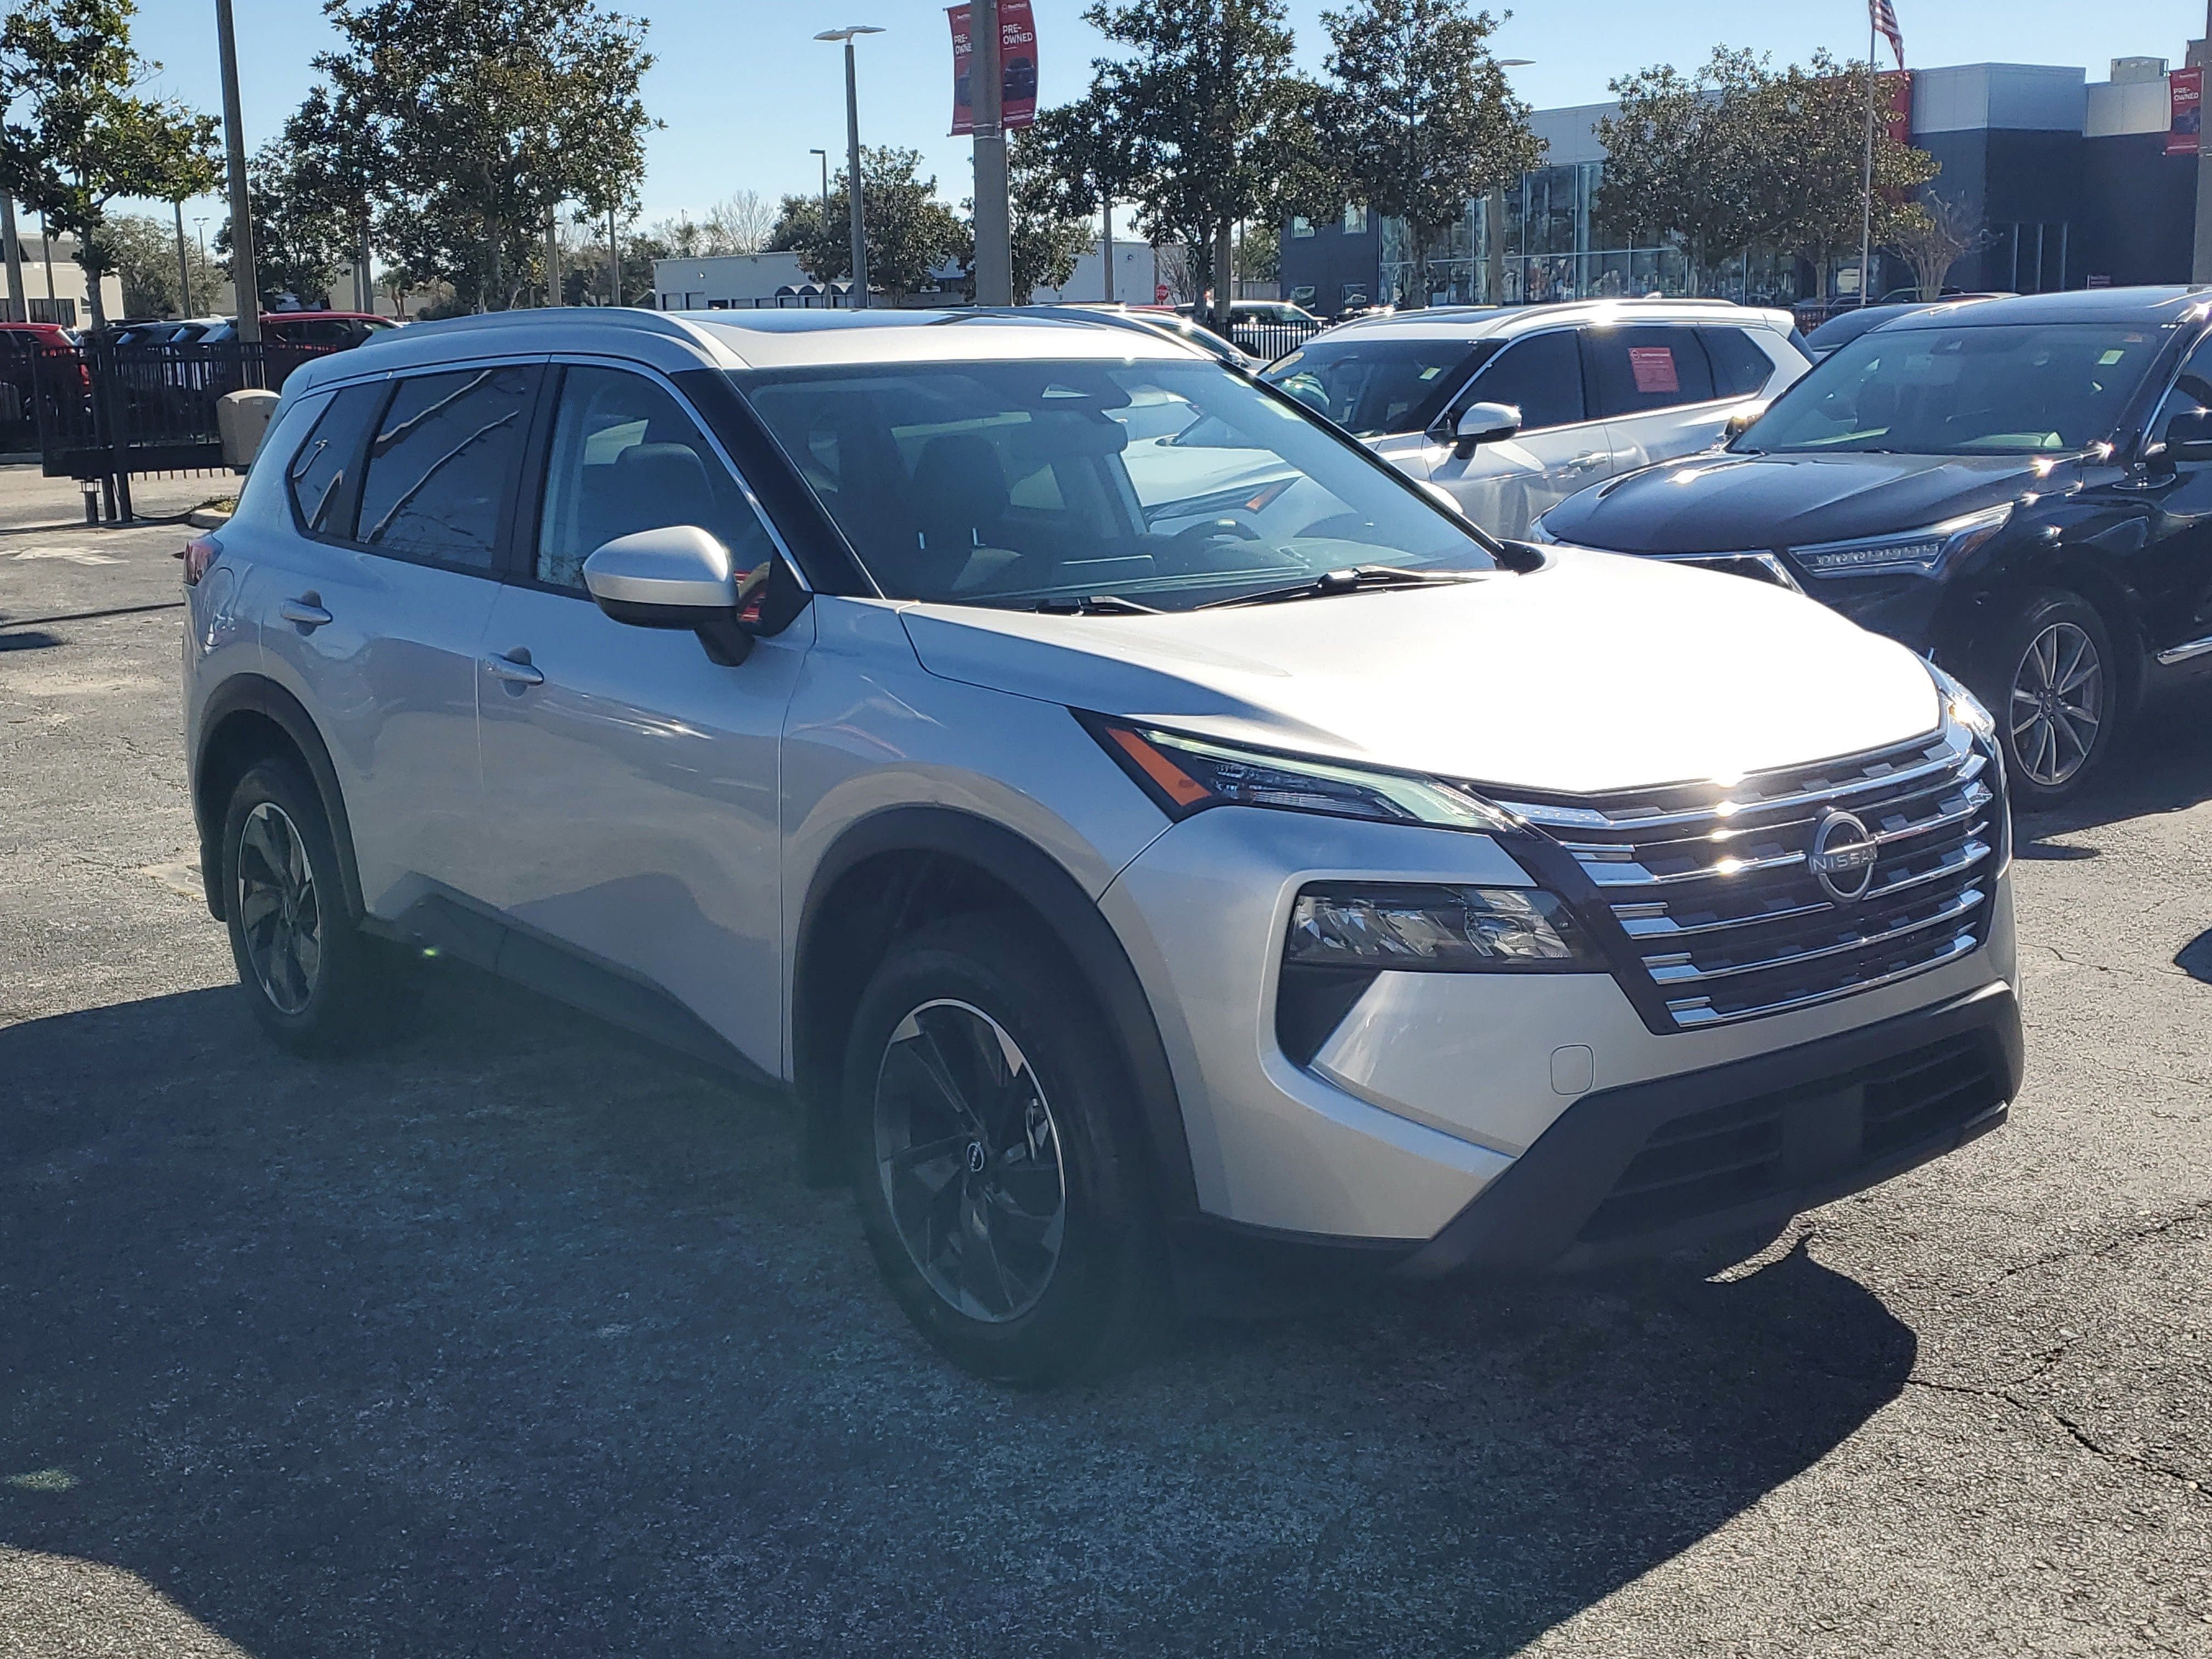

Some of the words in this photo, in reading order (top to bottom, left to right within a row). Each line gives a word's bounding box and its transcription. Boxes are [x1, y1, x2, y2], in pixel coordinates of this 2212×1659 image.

[1002, 23, 1023, 35] PRE-
[954, 33, 968, 45] PRE-
[1003, 32, 1033, 45] OWNED
[955, 43, 973, 55] OWNE
[1813, 847, 1877, 871] NISSAN
